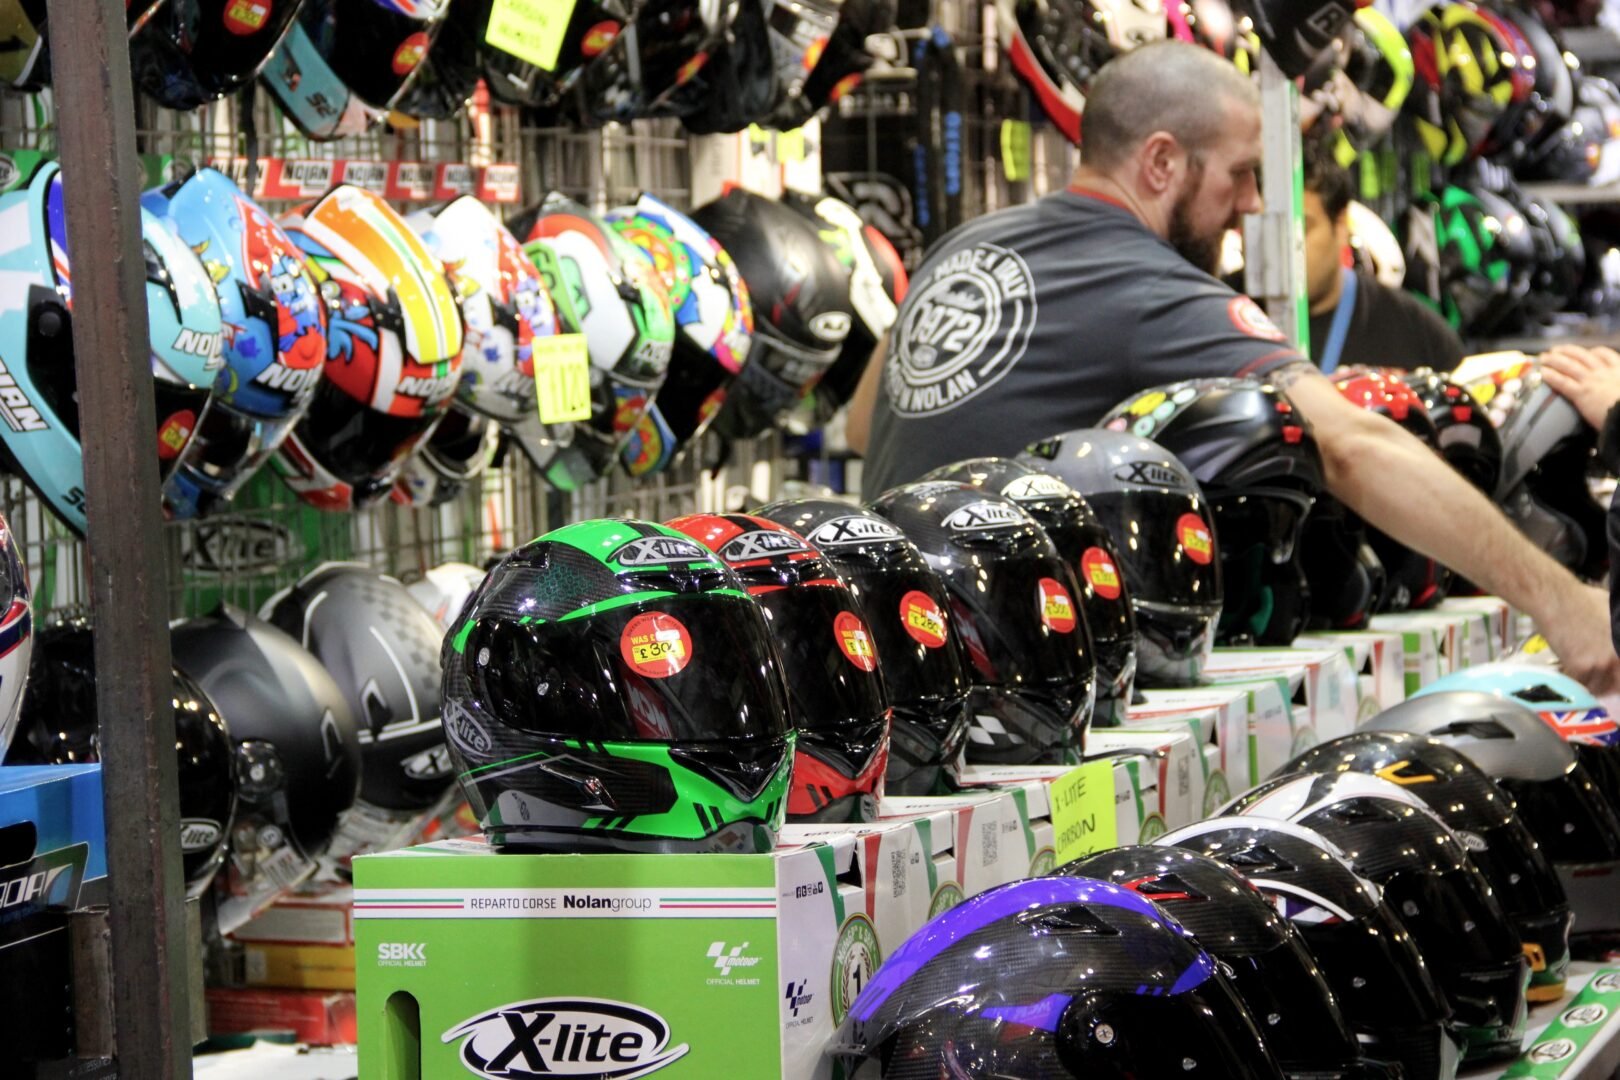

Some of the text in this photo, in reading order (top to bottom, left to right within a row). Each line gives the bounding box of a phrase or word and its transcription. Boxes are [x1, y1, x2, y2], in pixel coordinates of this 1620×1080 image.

[933, 248, 986, 281] MADE
[909, 301, 982, 352] 1972
[911, 368, 978, 411] NOLAN
[634, 539, 703, 564] X-lite
[631, 634, 648, 645] WAS
[446, 700, 485, 752] X-lite
[1056, 813, 1096, 855] CARBON
[471, 895, 652, 912] REPARTO CORSE Nolangroup
[484, 1012, 643, 1073] X-lite
